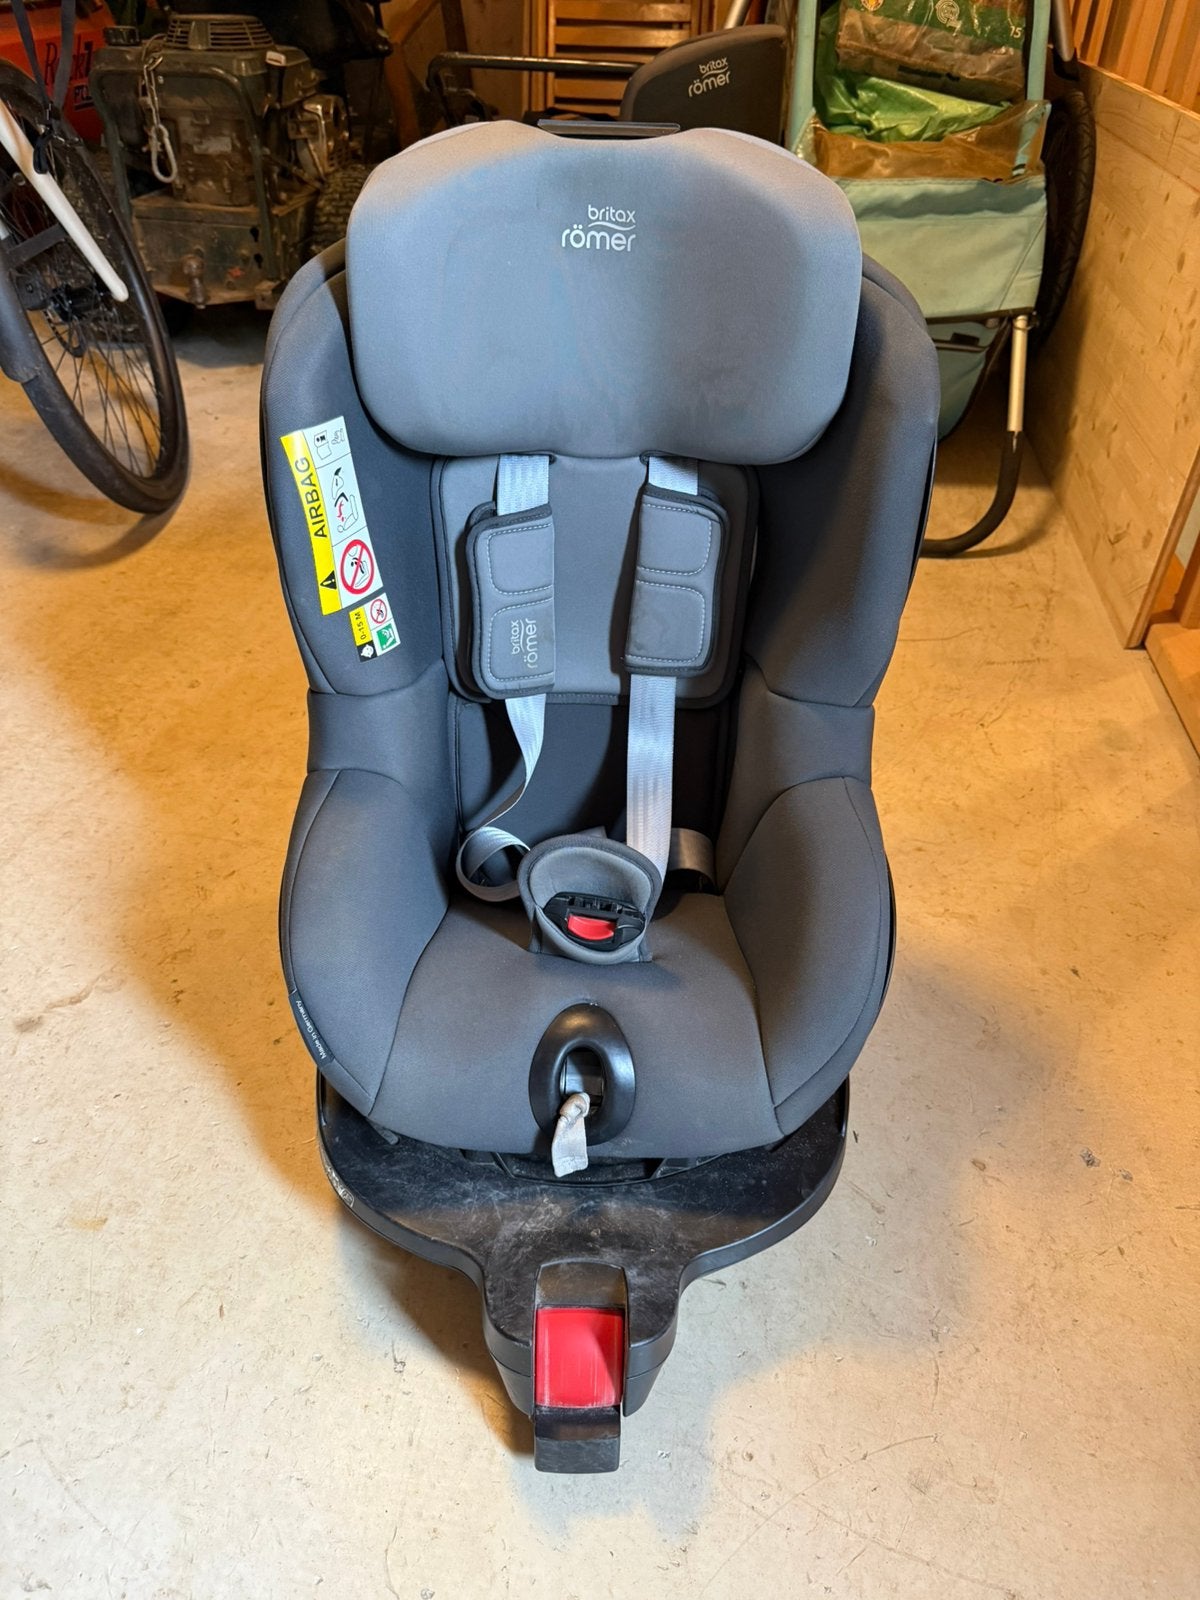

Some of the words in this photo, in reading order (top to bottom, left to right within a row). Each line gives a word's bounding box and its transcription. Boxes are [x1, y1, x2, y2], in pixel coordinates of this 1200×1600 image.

[699, 57, 728, 74] britax
[688, 71, 731, 97] römer
[588, 204, 636, 223] britax
[561, 224, 637, 252] römer
[295, 457, 328, 538] AIRBAG
[357, 621, 367, 640] 0-15
[510, 620, 520, 655] britax
[523, 618, 538, 669] römer
[295, 1000, 314, 1033] Germany
[314, 1040, 327, 1059] Made
